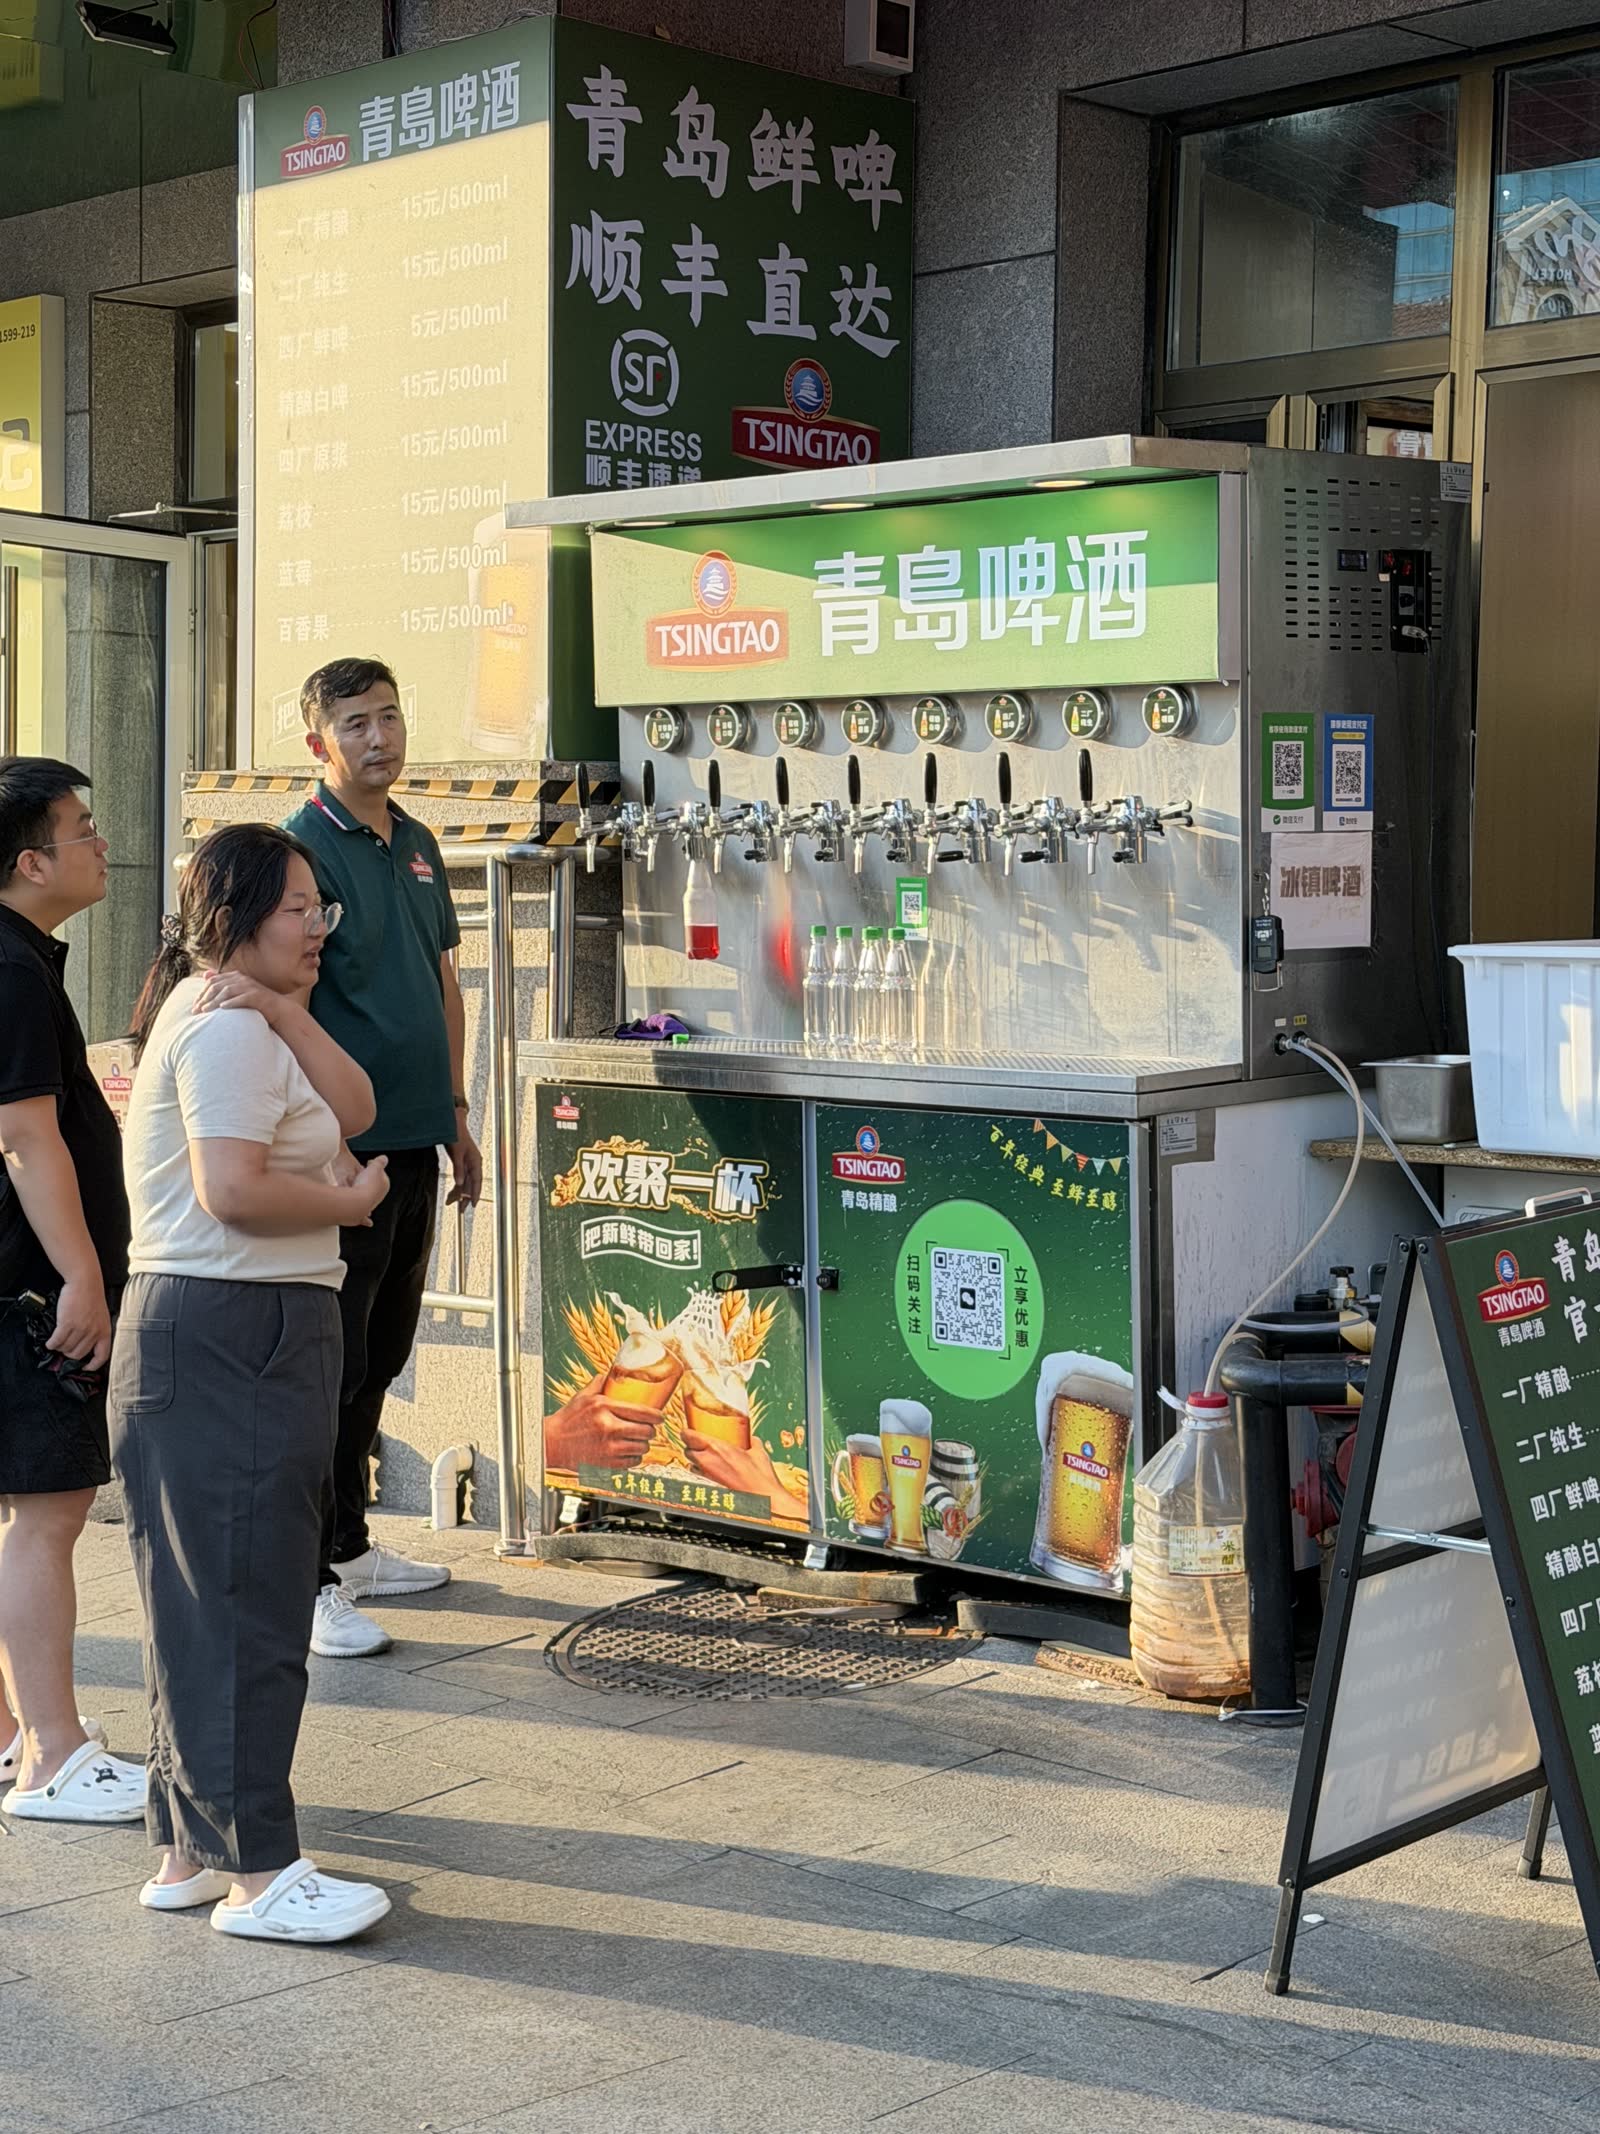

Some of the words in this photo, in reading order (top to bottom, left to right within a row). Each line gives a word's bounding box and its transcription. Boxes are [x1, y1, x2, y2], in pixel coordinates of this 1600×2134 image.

[285, 141, 346, 172] TSINGTAO
[565, 64, 902, 231] 青岛鲜啤
[402, 175, 508, 220] 15元/500ml
[402, 237, 508, 279] 15元/500ml
[565, 210, 901, 358] 顺丰直达
[401, 360, 508, 399] 15元/500ml
[401, 421, 508, 458] 15元/500ml
[585, 419, 702, 461] EXPRESS
[742, 417, 872, 465] TSINGTAO
[401, 480, 508, 517] 15元/500ml
[401, 541, 508, 575] 15元/500ml
[278, 615, 329, 642] 百香果
[401, 601, 508, 633] 15元/500ml
[655, 619, 780, 657] TSINGTAO
[1280, 866, 1361, 898] 冰镇啤酒
[579, 1153, 764, 1215] 欢聚一杯
[837, 1157, 901, 1179] TSINGTAO
[841, 1189, 897, 1212] 青岛精酿
[907, 1253, 922, 1335] 扫码关注
[1014, 1265, 1029, 1349] 立享优惠
[1482, 1283, 1545, 1316] TSINGTAO
[1563, 1296, 1600, 1344] 官
[1502, 1365, 1571, 1404] 一厂精酿
[1516, 1421, 1587, 1463] 二厂纯生
[1066, 1454, 1109, 1478] TSINGTAO
[1530, 1476, 1600, 1522] 四厂鲜啤
[1544, 1537, 1600, 1580] 精酿白
[1560, 1597, 1600, 1637] 四厂
